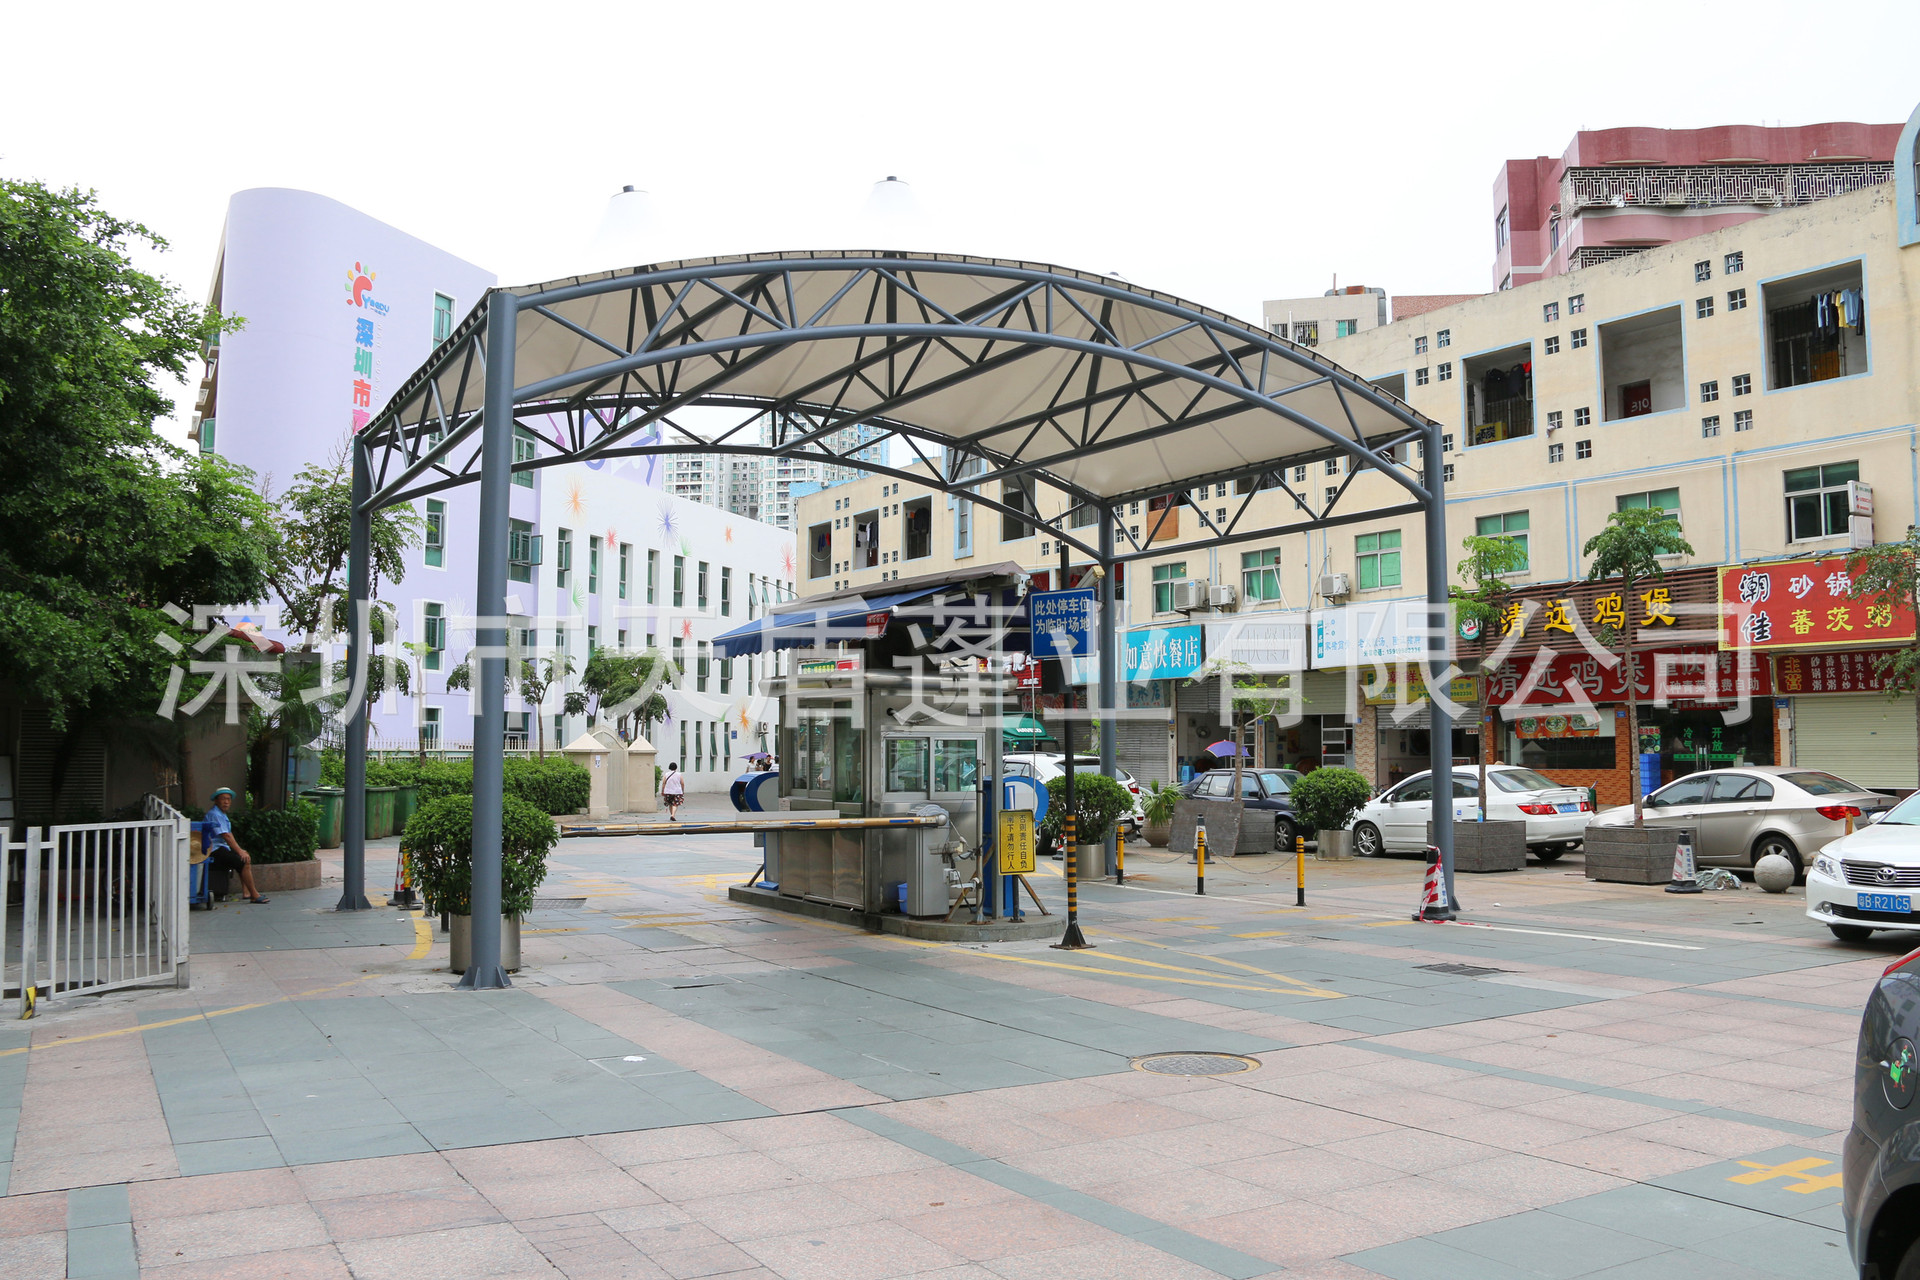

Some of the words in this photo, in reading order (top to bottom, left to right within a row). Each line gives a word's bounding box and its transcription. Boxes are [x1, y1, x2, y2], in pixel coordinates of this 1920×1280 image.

[1631, 398, 1650, 412] 310
[1034, 596, 1091, 616] 此处停车位
[1500, 588, 1676, 637] 清远鸡煲
[1035, 615, 1091, 635] 为临时场地
[1125, 635, 1199, 671] 如意快餐店
[1656, 652, 1760, 676] 重庆烤鱼
[1489, 653, 1650, 700] 清远鸡煲
[1658, 678, 1760, 694] 八种青菜免费自助
[1784, 656, 1802, 691] 主营
[1810, 655, 1822, 691] 砂锅粥
